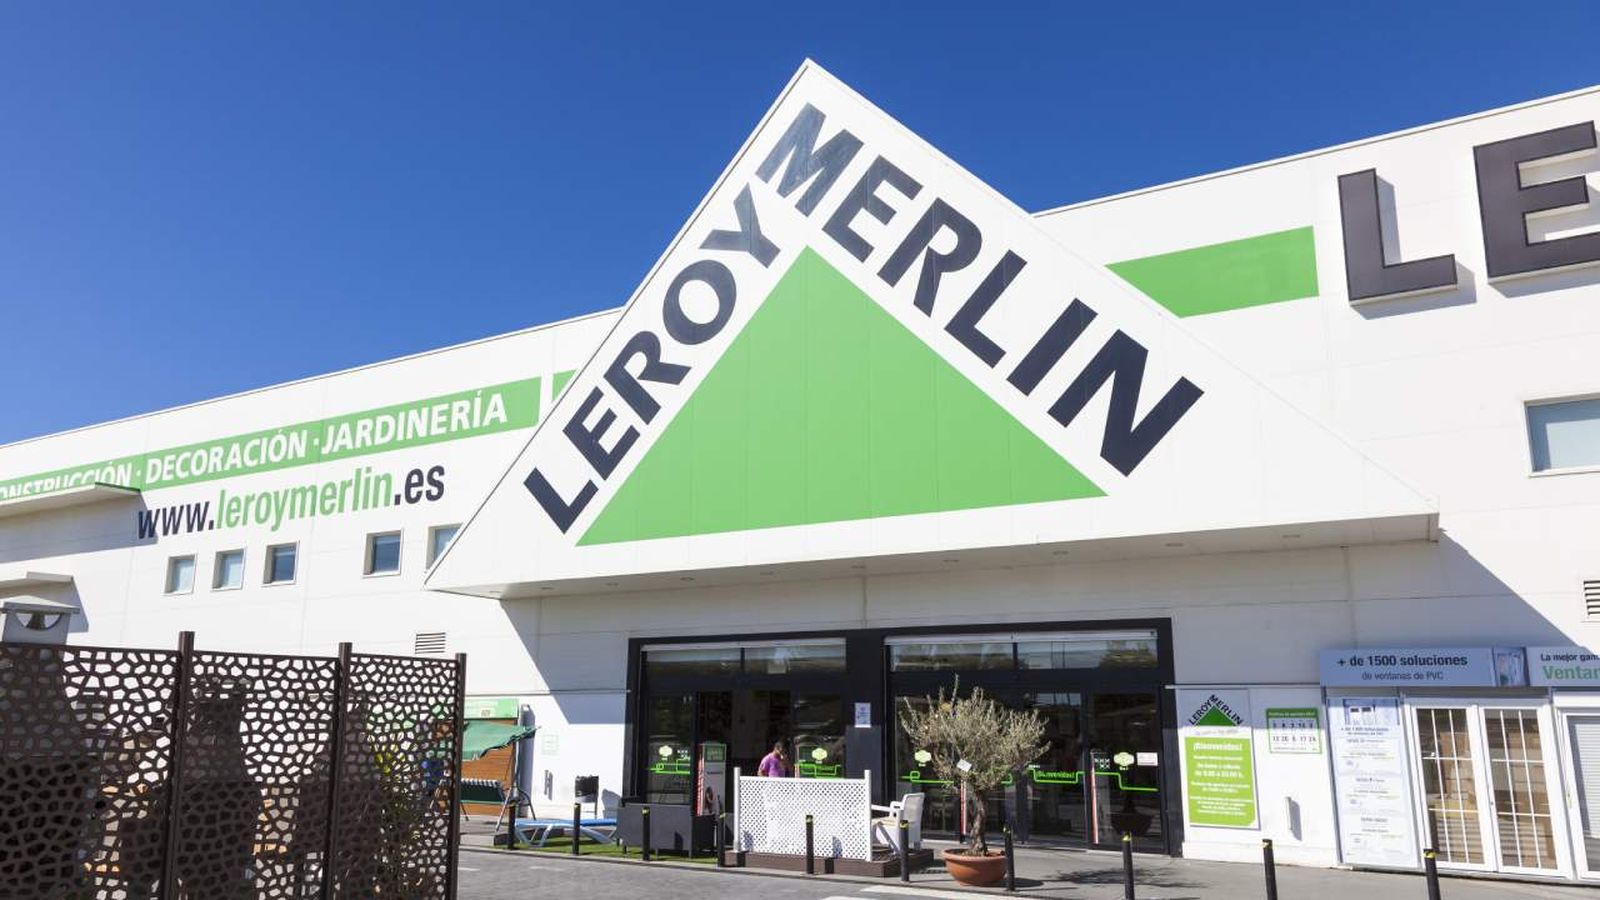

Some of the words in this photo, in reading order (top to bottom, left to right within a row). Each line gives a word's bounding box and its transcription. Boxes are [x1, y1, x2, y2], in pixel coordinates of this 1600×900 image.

[1337, 120, 1600, 305] LE
[755, 101, 1205, 478] MERLIN
[523, 182, 781, 535] LEROY
[145, 429, 308, 485] DECORACIÓN
[321, 390, 508, 455] JARDINERÍA
[138, 465, 445, 539] www.leroymerlin.es
[1350, 655, 1364, 667] de
[1369, 655, 1397, 666] 1500
[1400, 654, 1469, 666] soluciones
[1375, 671, 1413, 680] ventanas
[1426, 671, 1445, 680] PVC
[1553, 653, 1578, 663] mejor
[1189, 700, 1212, 725] LEROY
[1208, 694, 1243, 725] MERLIN
